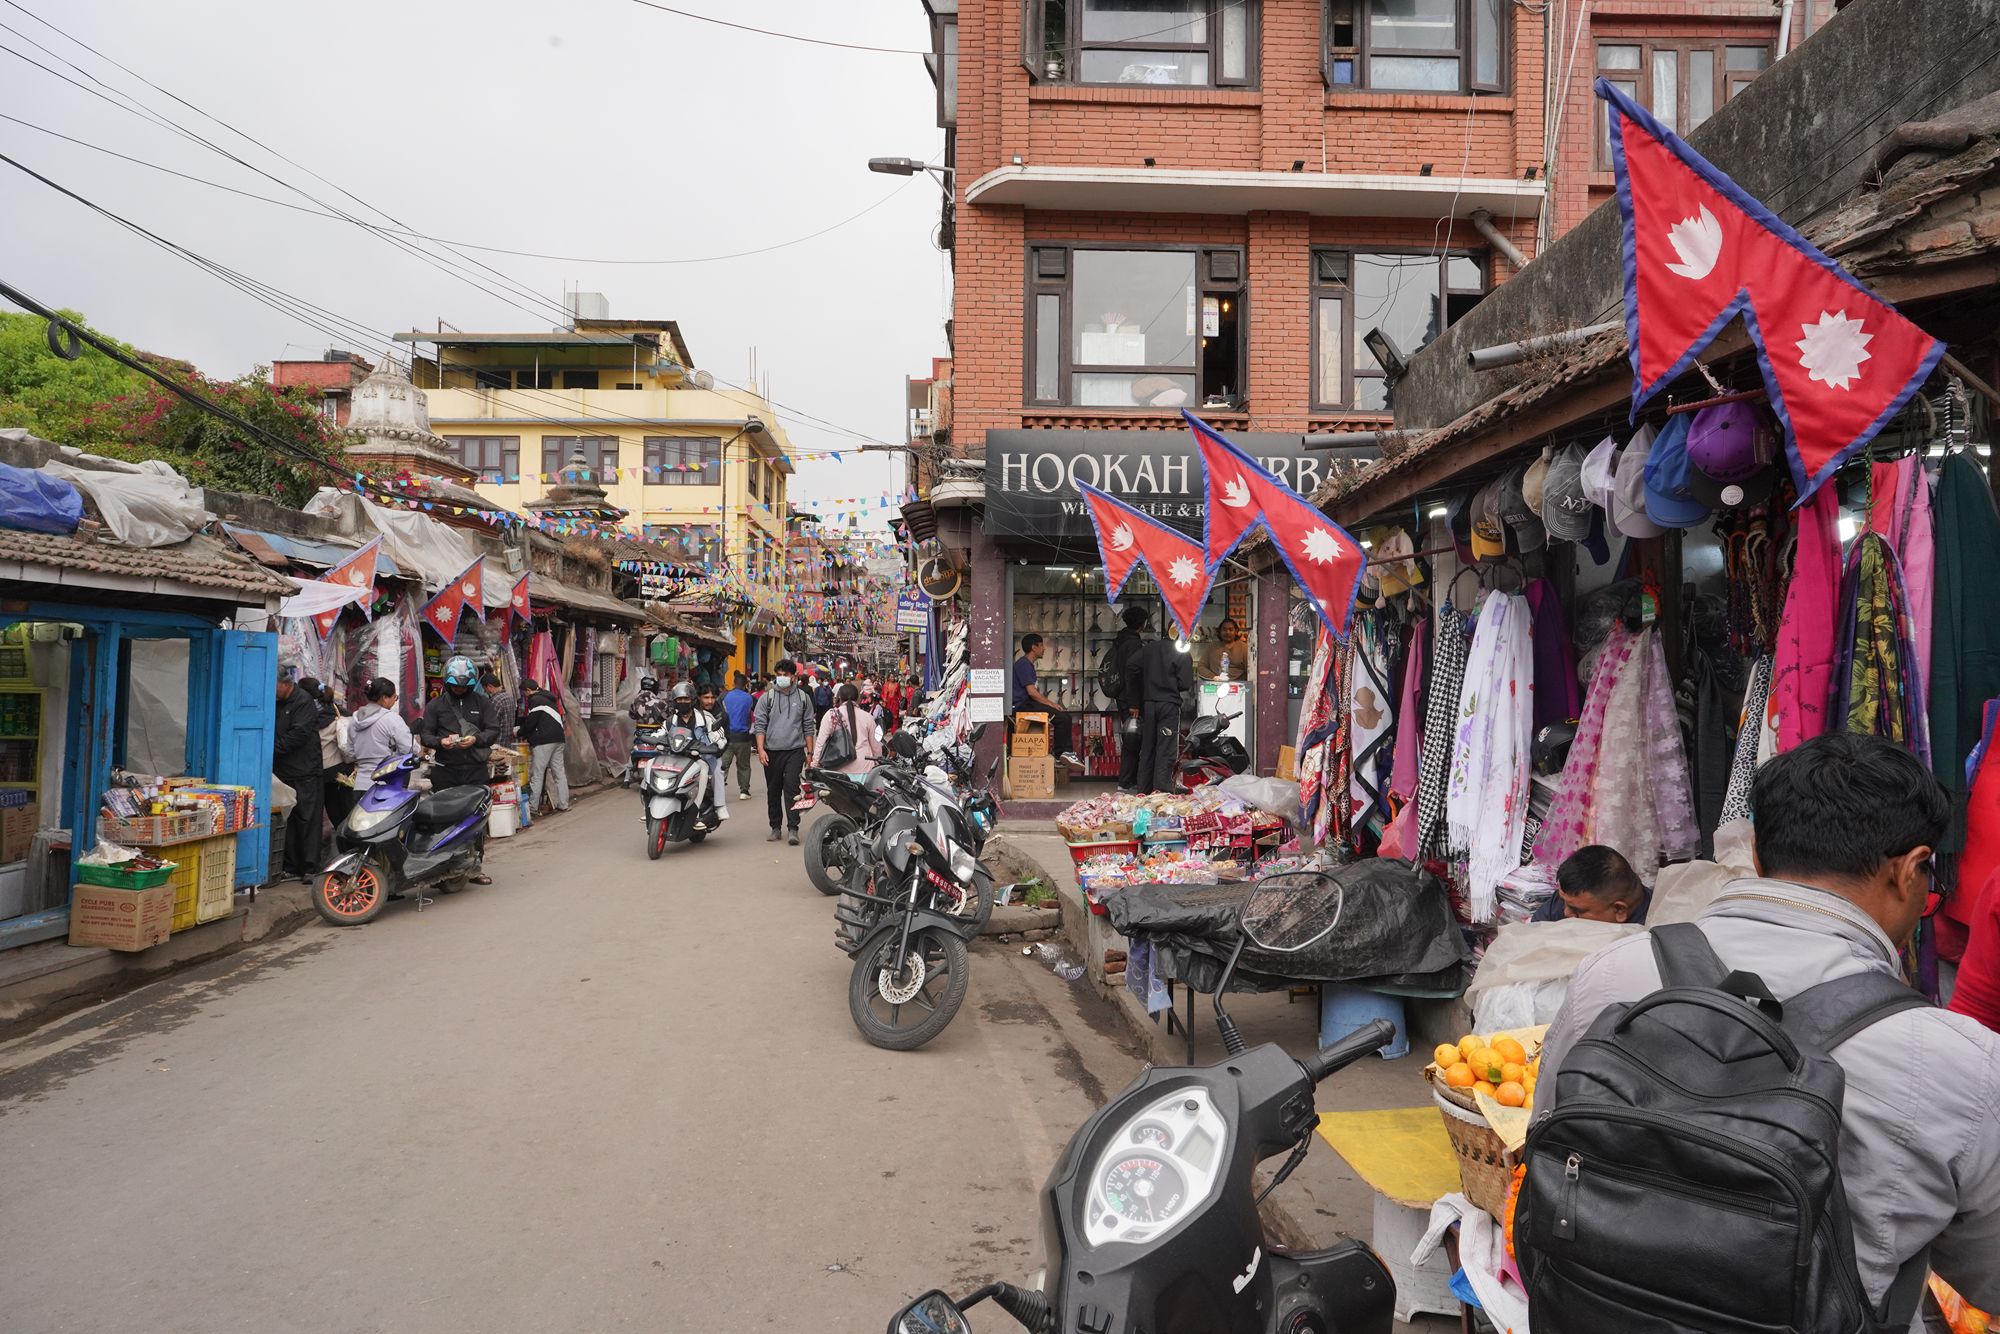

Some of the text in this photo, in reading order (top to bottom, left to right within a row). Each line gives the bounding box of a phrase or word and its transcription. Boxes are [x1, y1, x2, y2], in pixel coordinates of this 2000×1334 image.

[1000, 453, 1191, 494] HOOKAH
[1177, 503, 1190, 517] &
[1014, 736, 1045, 744] JALAPA
[1149, 1169, 1161, 1181] 120
